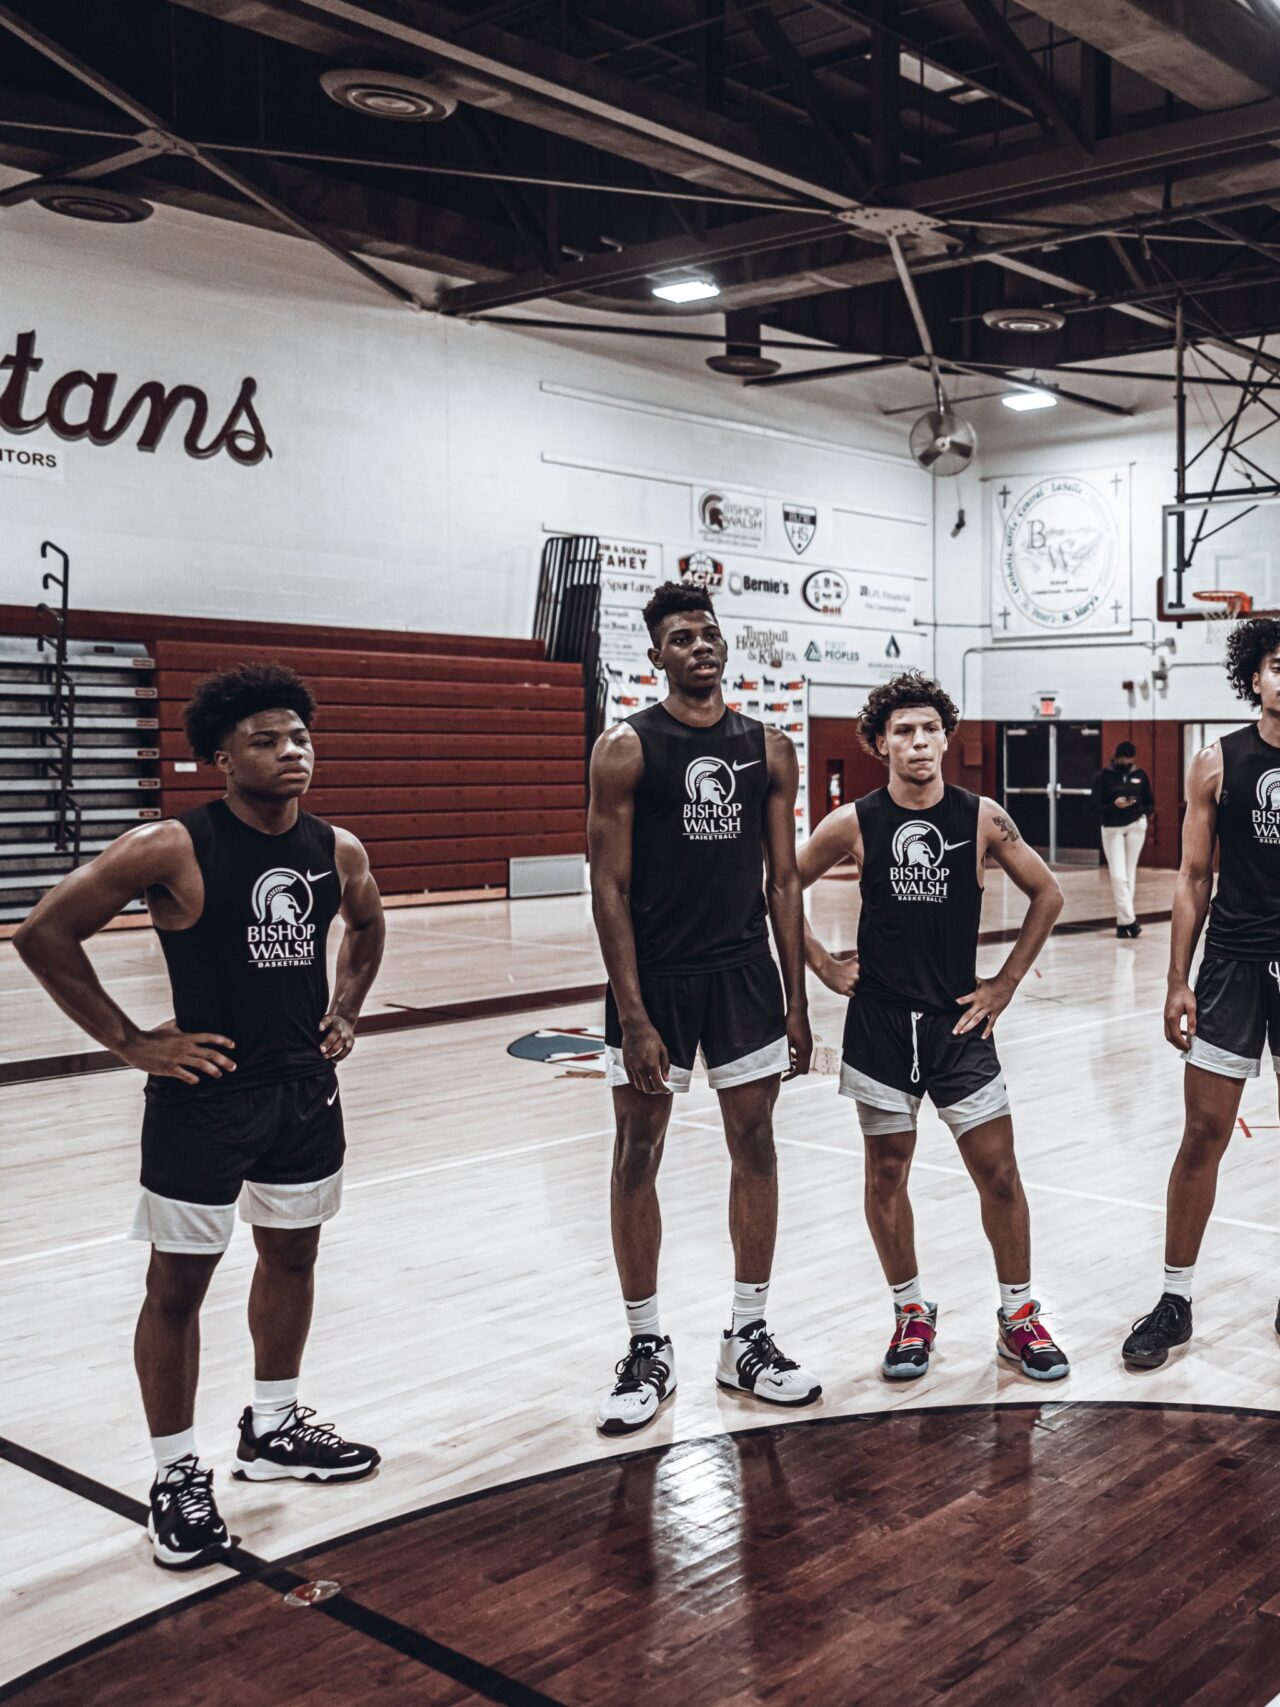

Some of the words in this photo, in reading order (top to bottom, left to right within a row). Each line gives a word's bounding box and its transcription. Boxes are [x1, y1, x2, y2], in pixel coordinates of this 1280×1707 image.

[723, 503, 762, 517] BISHOP
[724, 515, 762, 530] WALSH
[791, 525, 809, 542] HS
[622, 546, 647, 555] SUSAN
[597, 553, 647, 570] FAHEY
[743, 575, 789, 595] Bernie's
[743, 625, 788, 643] Turnbull
[825, 650, 860, 662] PEOPLES
[683, 803, 742, 818] BISHOP
[684, 818, 741, 832] WALSH
[889, 867, 950, 881] BISHOP
[891, 881, 948, 896] WALSH
[898, 895, 943, 903] BASKETBALL
[248, 924, 316, 942] BISHOP
[249, 941, 314, 960] WALSH
[258, 960, 312, 968] BASKETBALL
